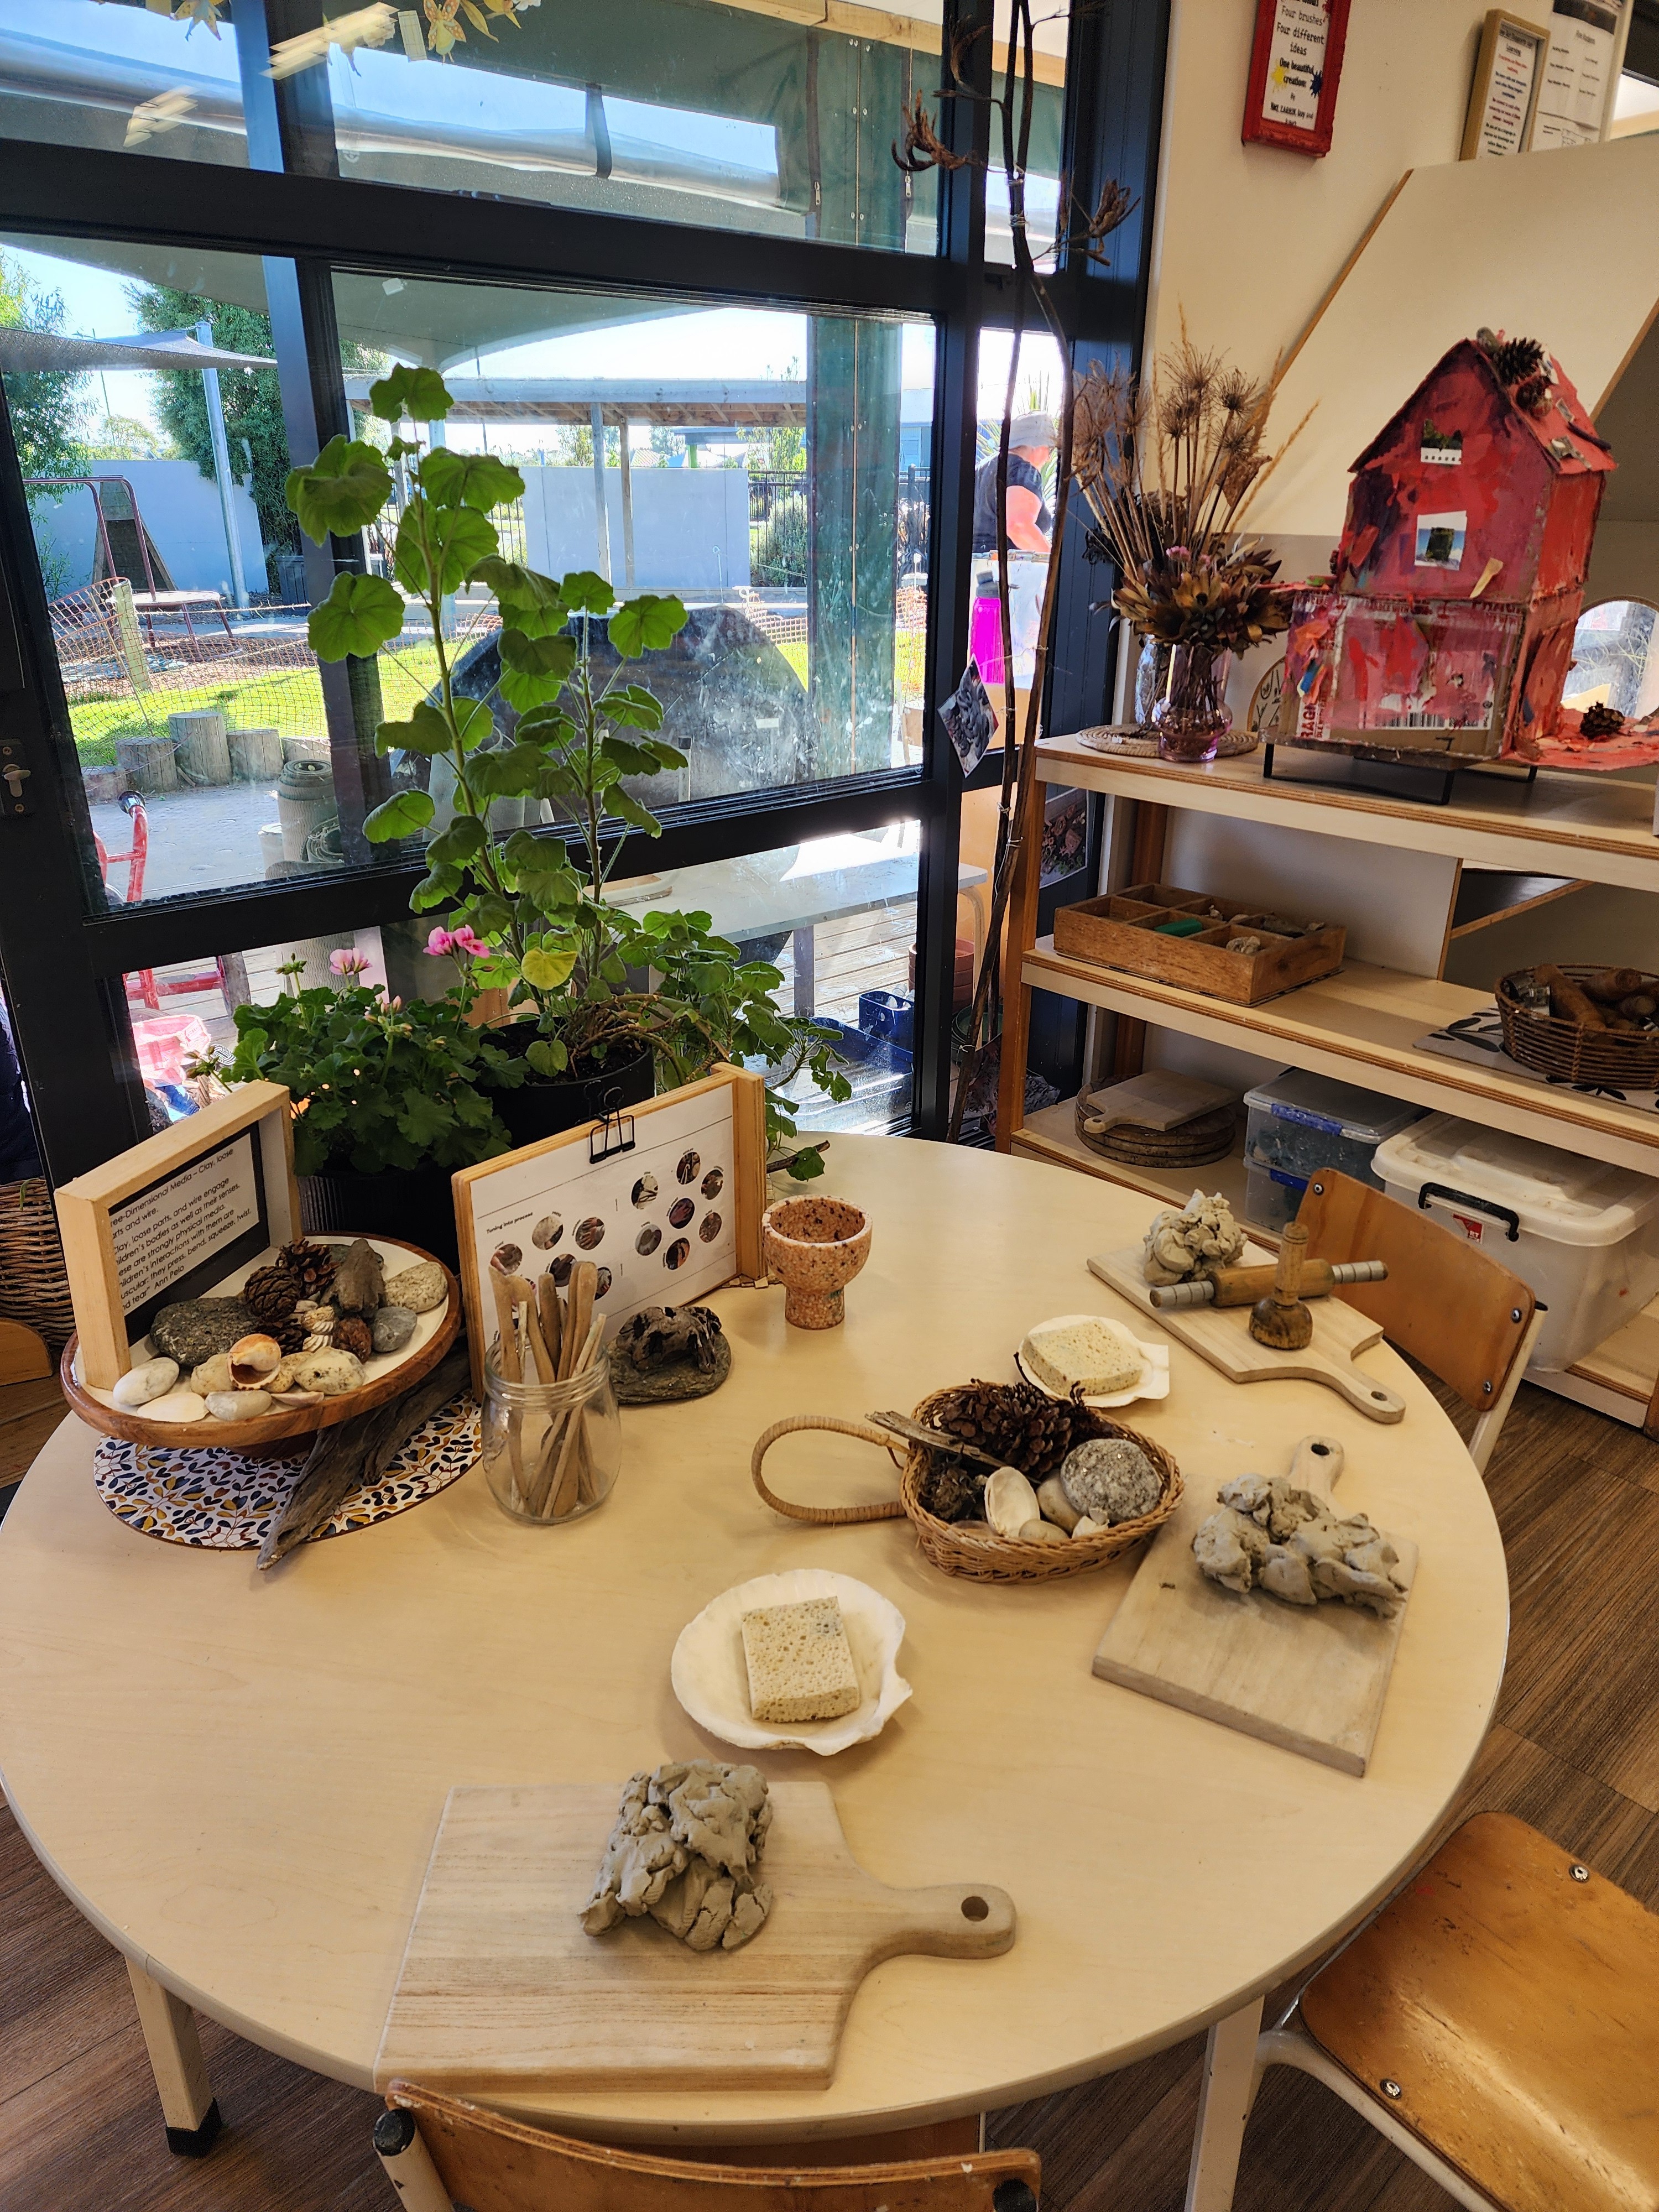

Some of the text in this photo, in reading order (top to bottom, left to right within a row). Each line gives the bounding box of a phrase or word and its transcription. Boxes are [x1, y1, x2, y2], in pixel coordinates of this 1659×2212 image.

[1281, 5, 1322, 26] Four brushes
[1277, 22, 1324, 45] Four different
[1290, 41, 1307, 56] ideas
[170, 1174, 192, 1191] Media
[199, 1161, 215, 1173] Clay,
[217, 1149, 233, 1162] loose
[126, 1216, 140, 1230] and
[142, 1208, 158, 1220] wire.
[132, 1228, 150, 1243] loose
[173, 1203, 187, 1217] and
[188, 1195, 202, 1207] wire
[204, 1178, 229, 1197] engage
[146, 1228, 169, 1246] bodies
[171, 1222, 179, 1230] as
[180, 1211, 194, 1224] well
[204, 1196, 217, 1209] their
[118, 1204, 226, 1276] ese are strongly physical media.
[150, 1239, 189, 1269] interactions
[191, 1229, 204, 1241] with
[206, 1217, 222, 1232] them
[223, 1209, 234, 1220] are
[150, 1266, 166, 1280] they
[154, 1276, 168, 1290] Ann
[169, 1265, 184, 1279] Pelo
